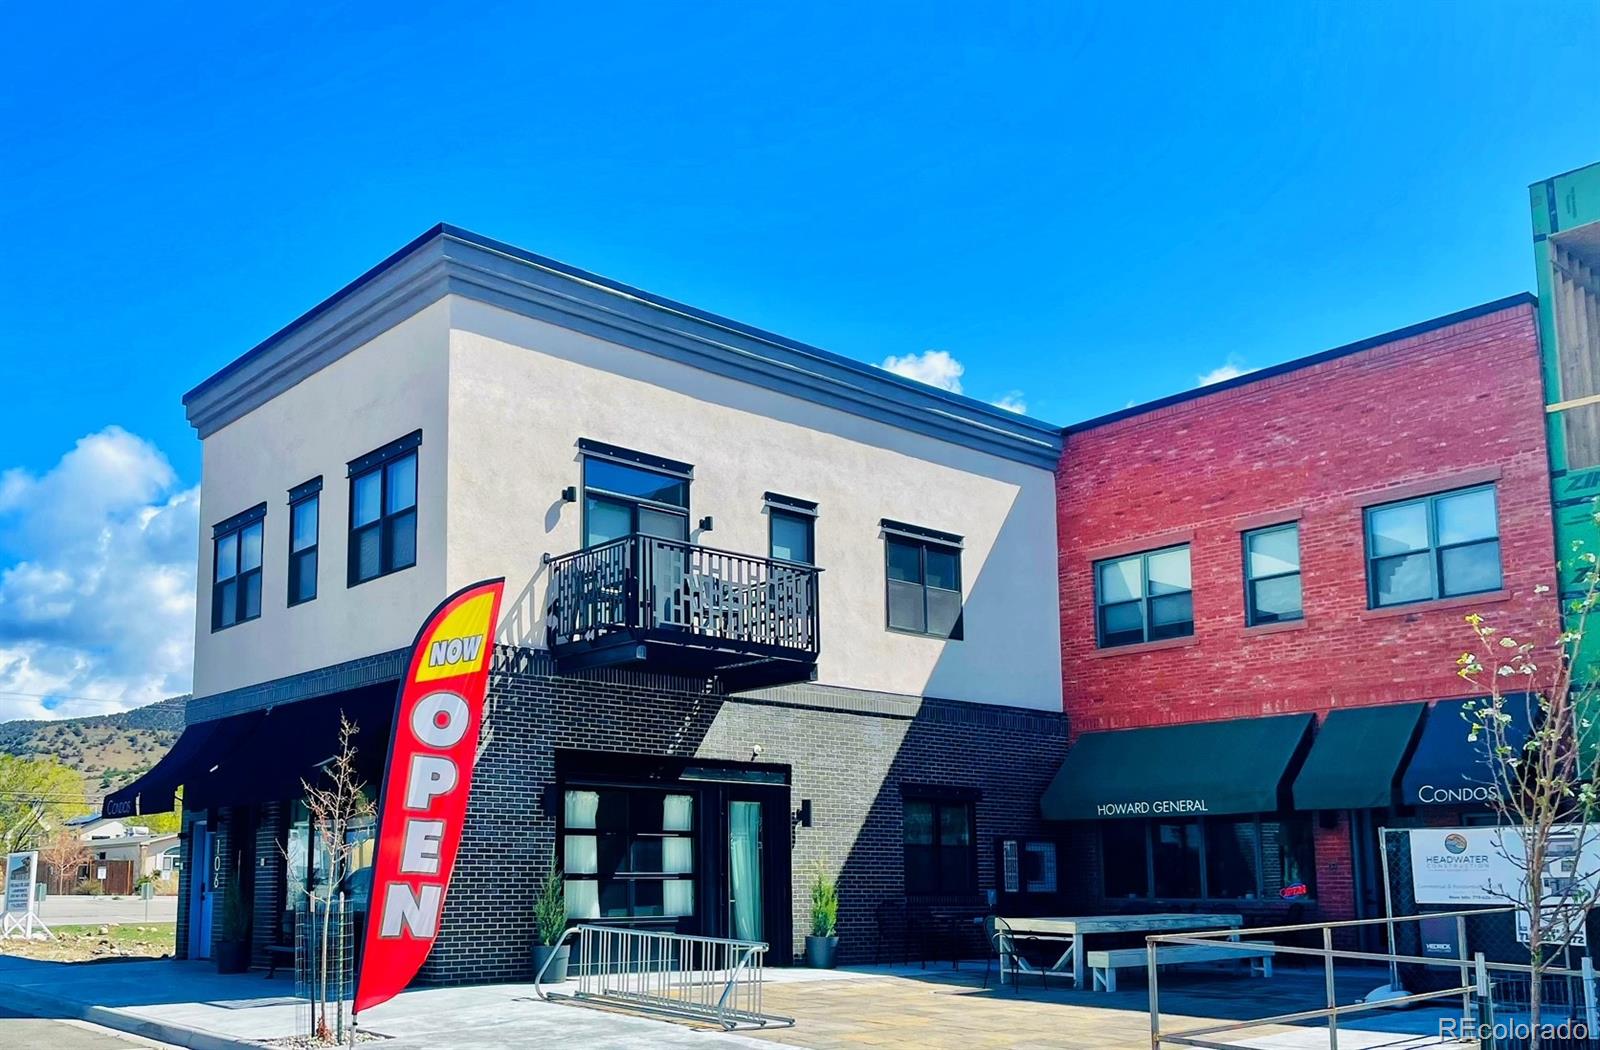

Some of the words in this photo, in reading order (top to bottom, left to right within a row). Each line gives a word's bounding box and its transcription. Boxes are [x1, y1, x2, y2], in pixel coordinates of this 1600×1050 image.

[429, 635, 482, 667] NOW
[380, 691, 470, 939] OPEN
[1097, 801, 1150, 815] HOWARD
[1153, 800, 1208, 813] GENERAL
[1426, 855, 1489, 864] HEADWATER
